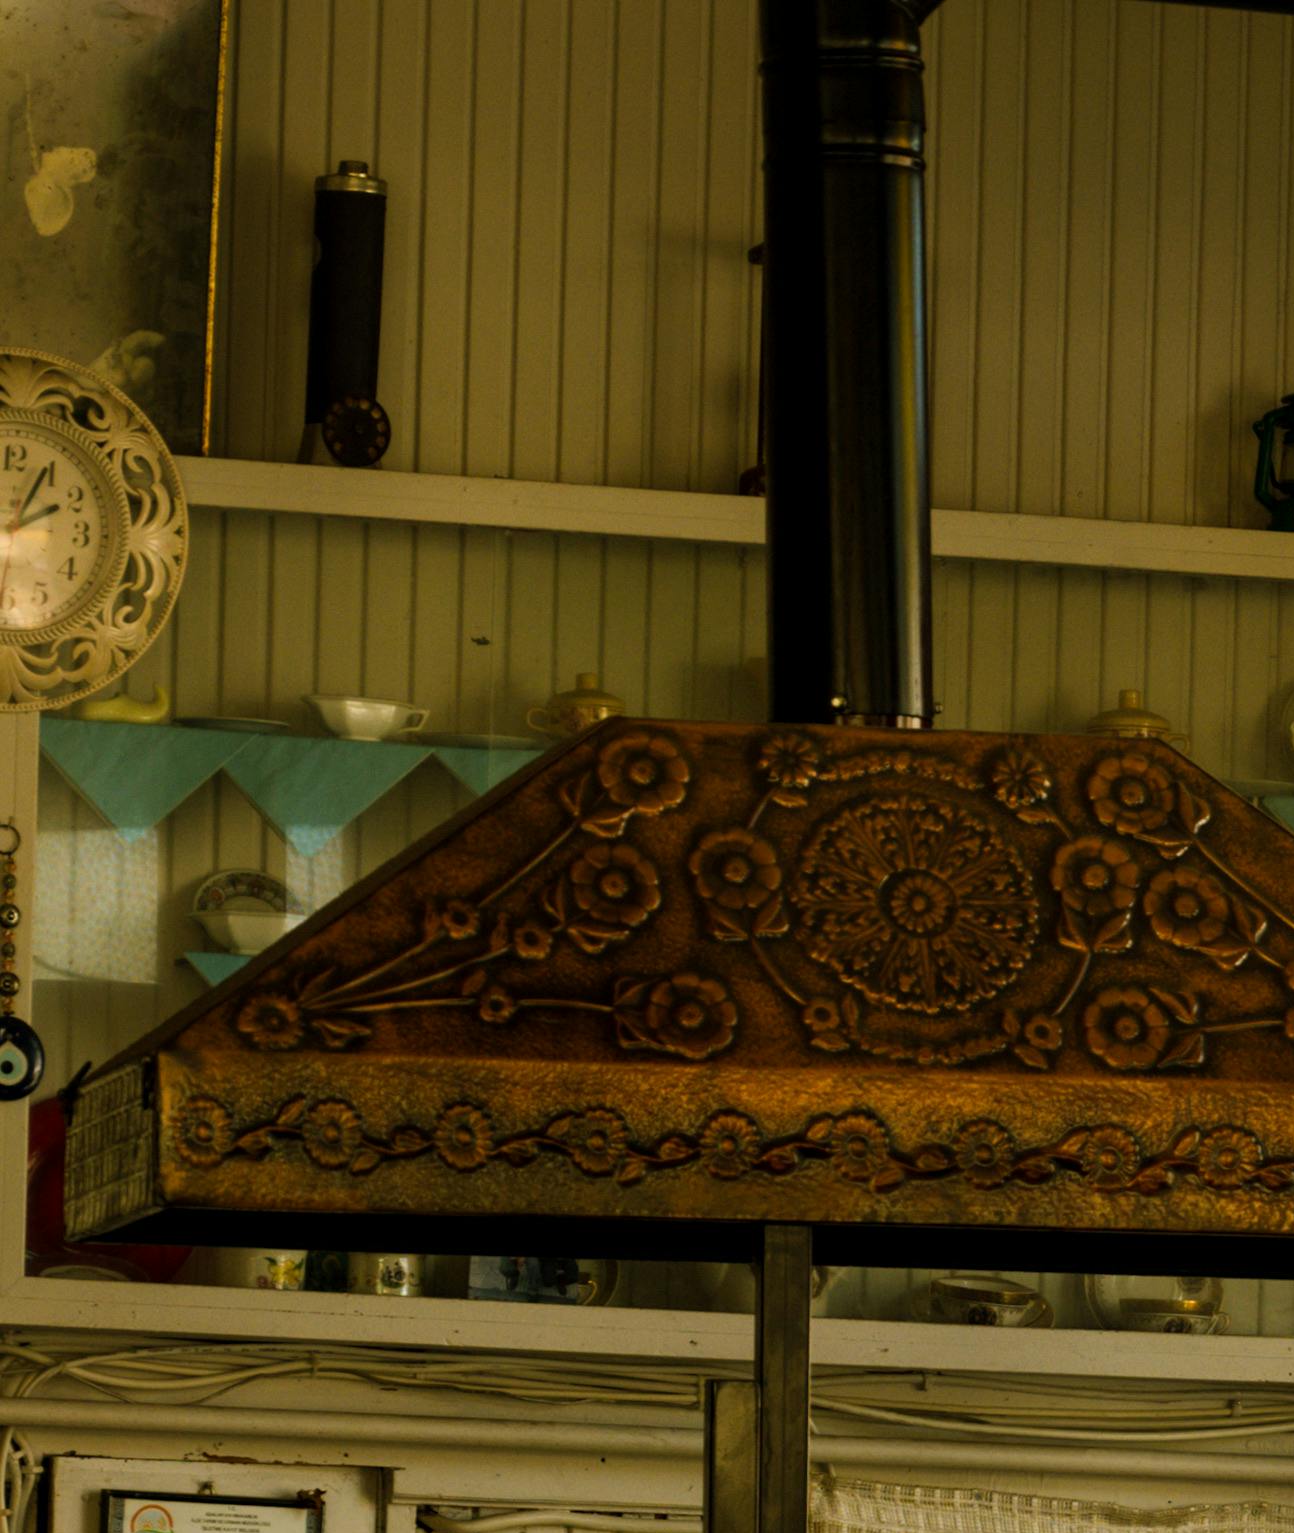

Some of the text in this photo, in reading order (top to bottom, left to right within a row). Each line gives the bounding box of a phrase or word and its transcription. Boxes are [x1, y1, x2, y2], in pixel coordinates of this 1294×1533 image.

[3, 444, 28, 473] 12
[48, 461, 56, 486] 1
[67, 485, 84, 512] 2
[72, 521, 90, 548] 3
[56, 556, 78, 581] 4
[31, 581, 49, 606] 5
